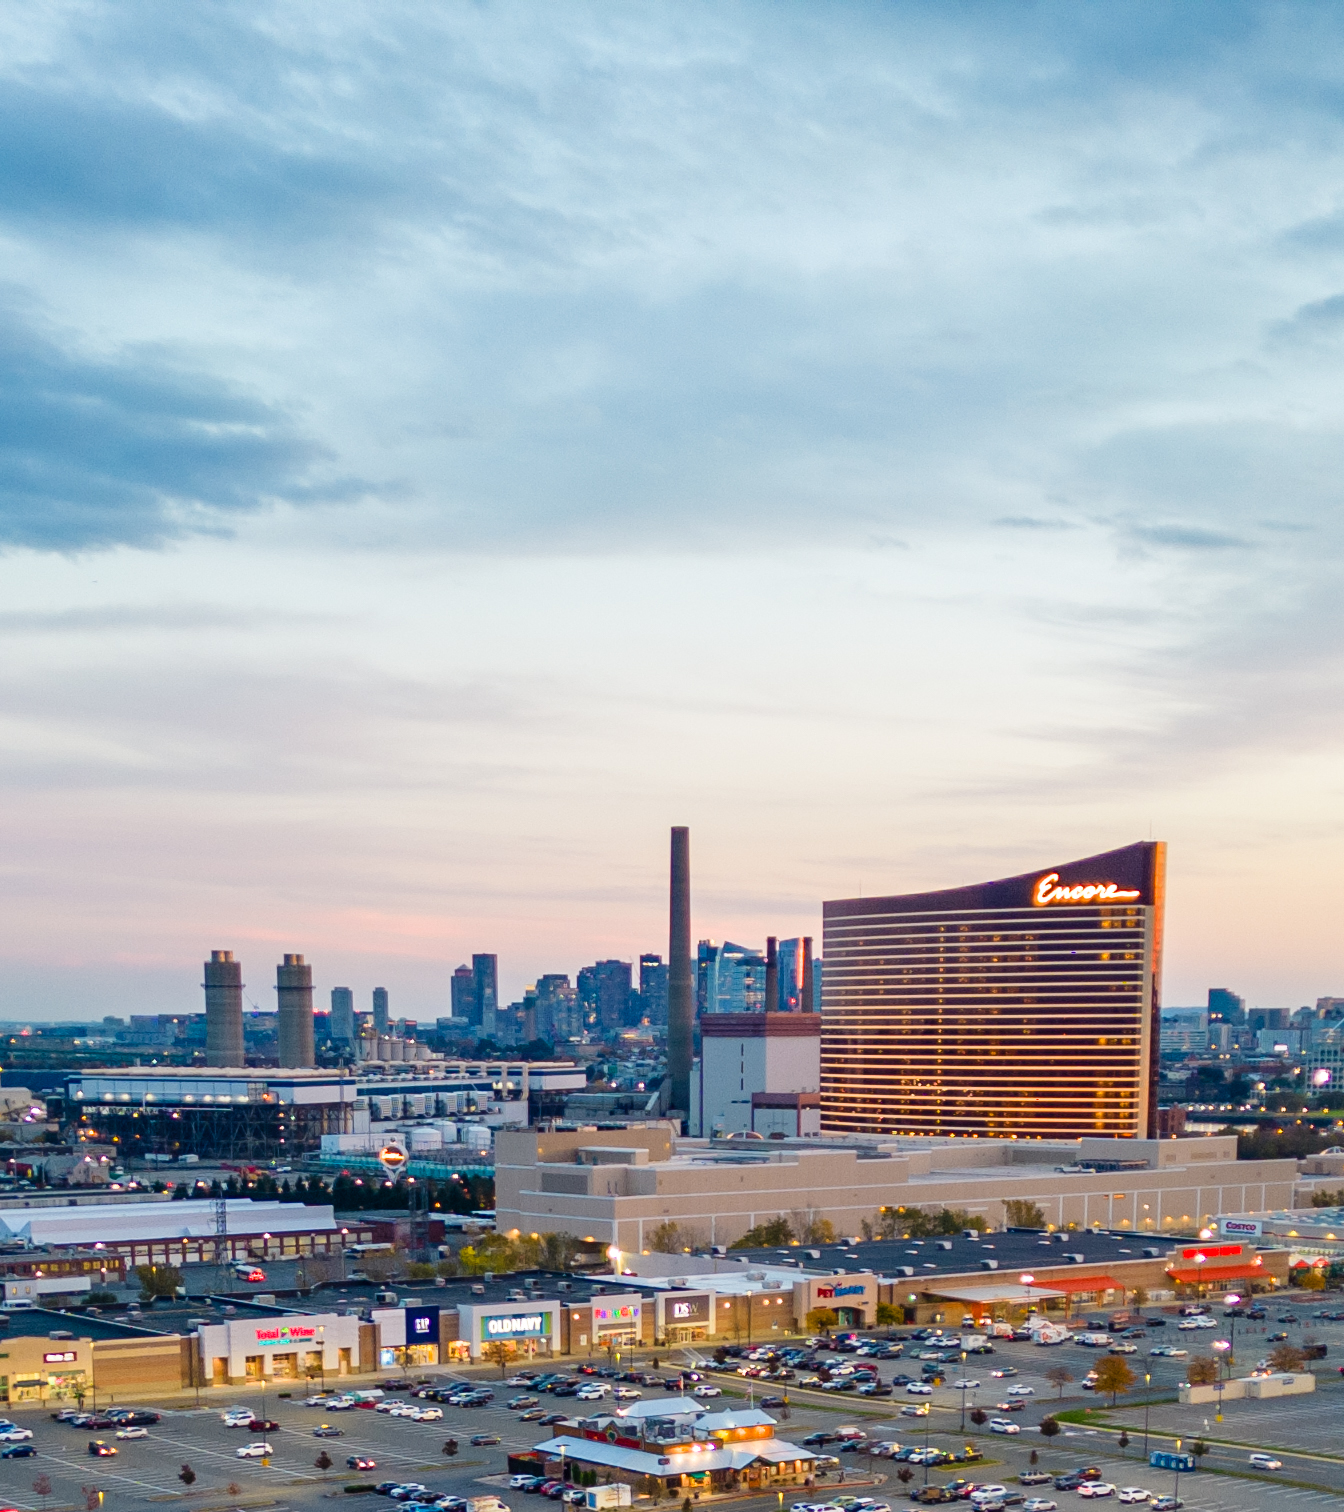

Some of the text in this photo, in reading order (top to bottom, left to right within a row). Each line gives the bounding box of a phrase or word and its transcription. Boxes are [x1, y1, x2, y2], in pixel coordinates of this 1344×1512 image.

[1037, 873, 1141, 903] Encore
[488, 1316, 542, 1334] OLD NAVY
